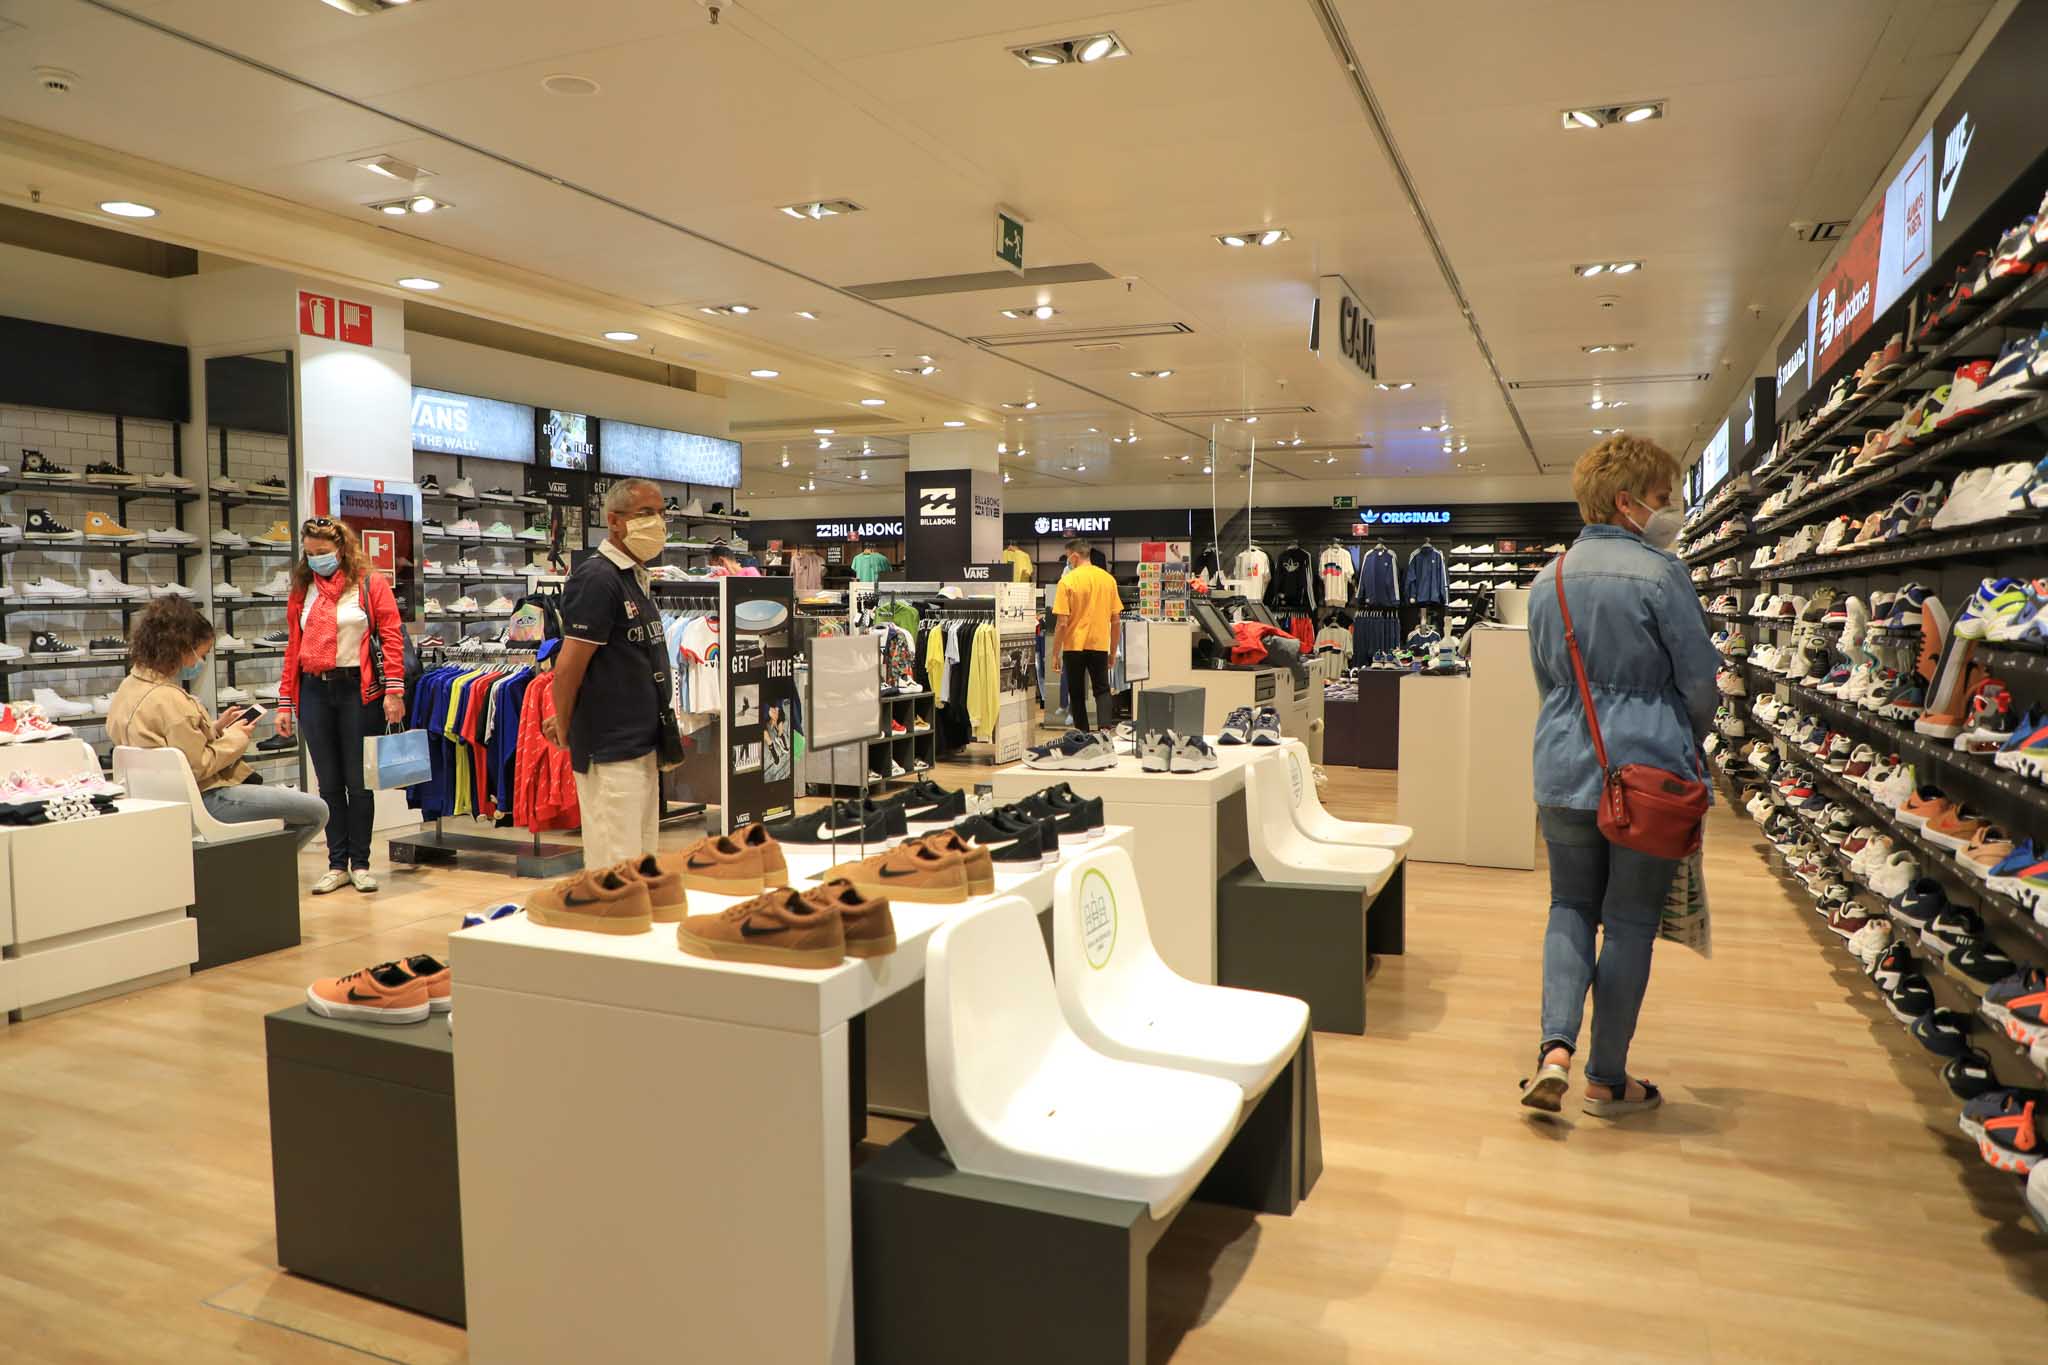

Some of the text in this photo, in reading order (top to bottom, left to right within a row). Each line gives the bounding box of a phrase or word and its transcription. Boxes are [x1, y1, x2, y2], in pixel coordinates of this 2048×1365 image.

[1942, 111, 1970, 179] NIKE
[1845, 281, 1870, 327] balance
[1340, 296, 1377, 380] CAJA
[543, 424, 556, 436] GET
[421, 433, 442, 447] THE
[548, 481, 568, 493] VANS
[594, 482, 607, 493] GET
[920, 517, 957, 526] BILLABONG
[1381, 511, 1451, 524] ORIGINALS
[832, 522, 903, 537] BILLABONG
[1051, 518, 1111, 531] ELEMENT
[963, 567, 990, 579] VANS
[732, 655, 792, 678] GET THERE
[736, 812, 751, 824] VANS
